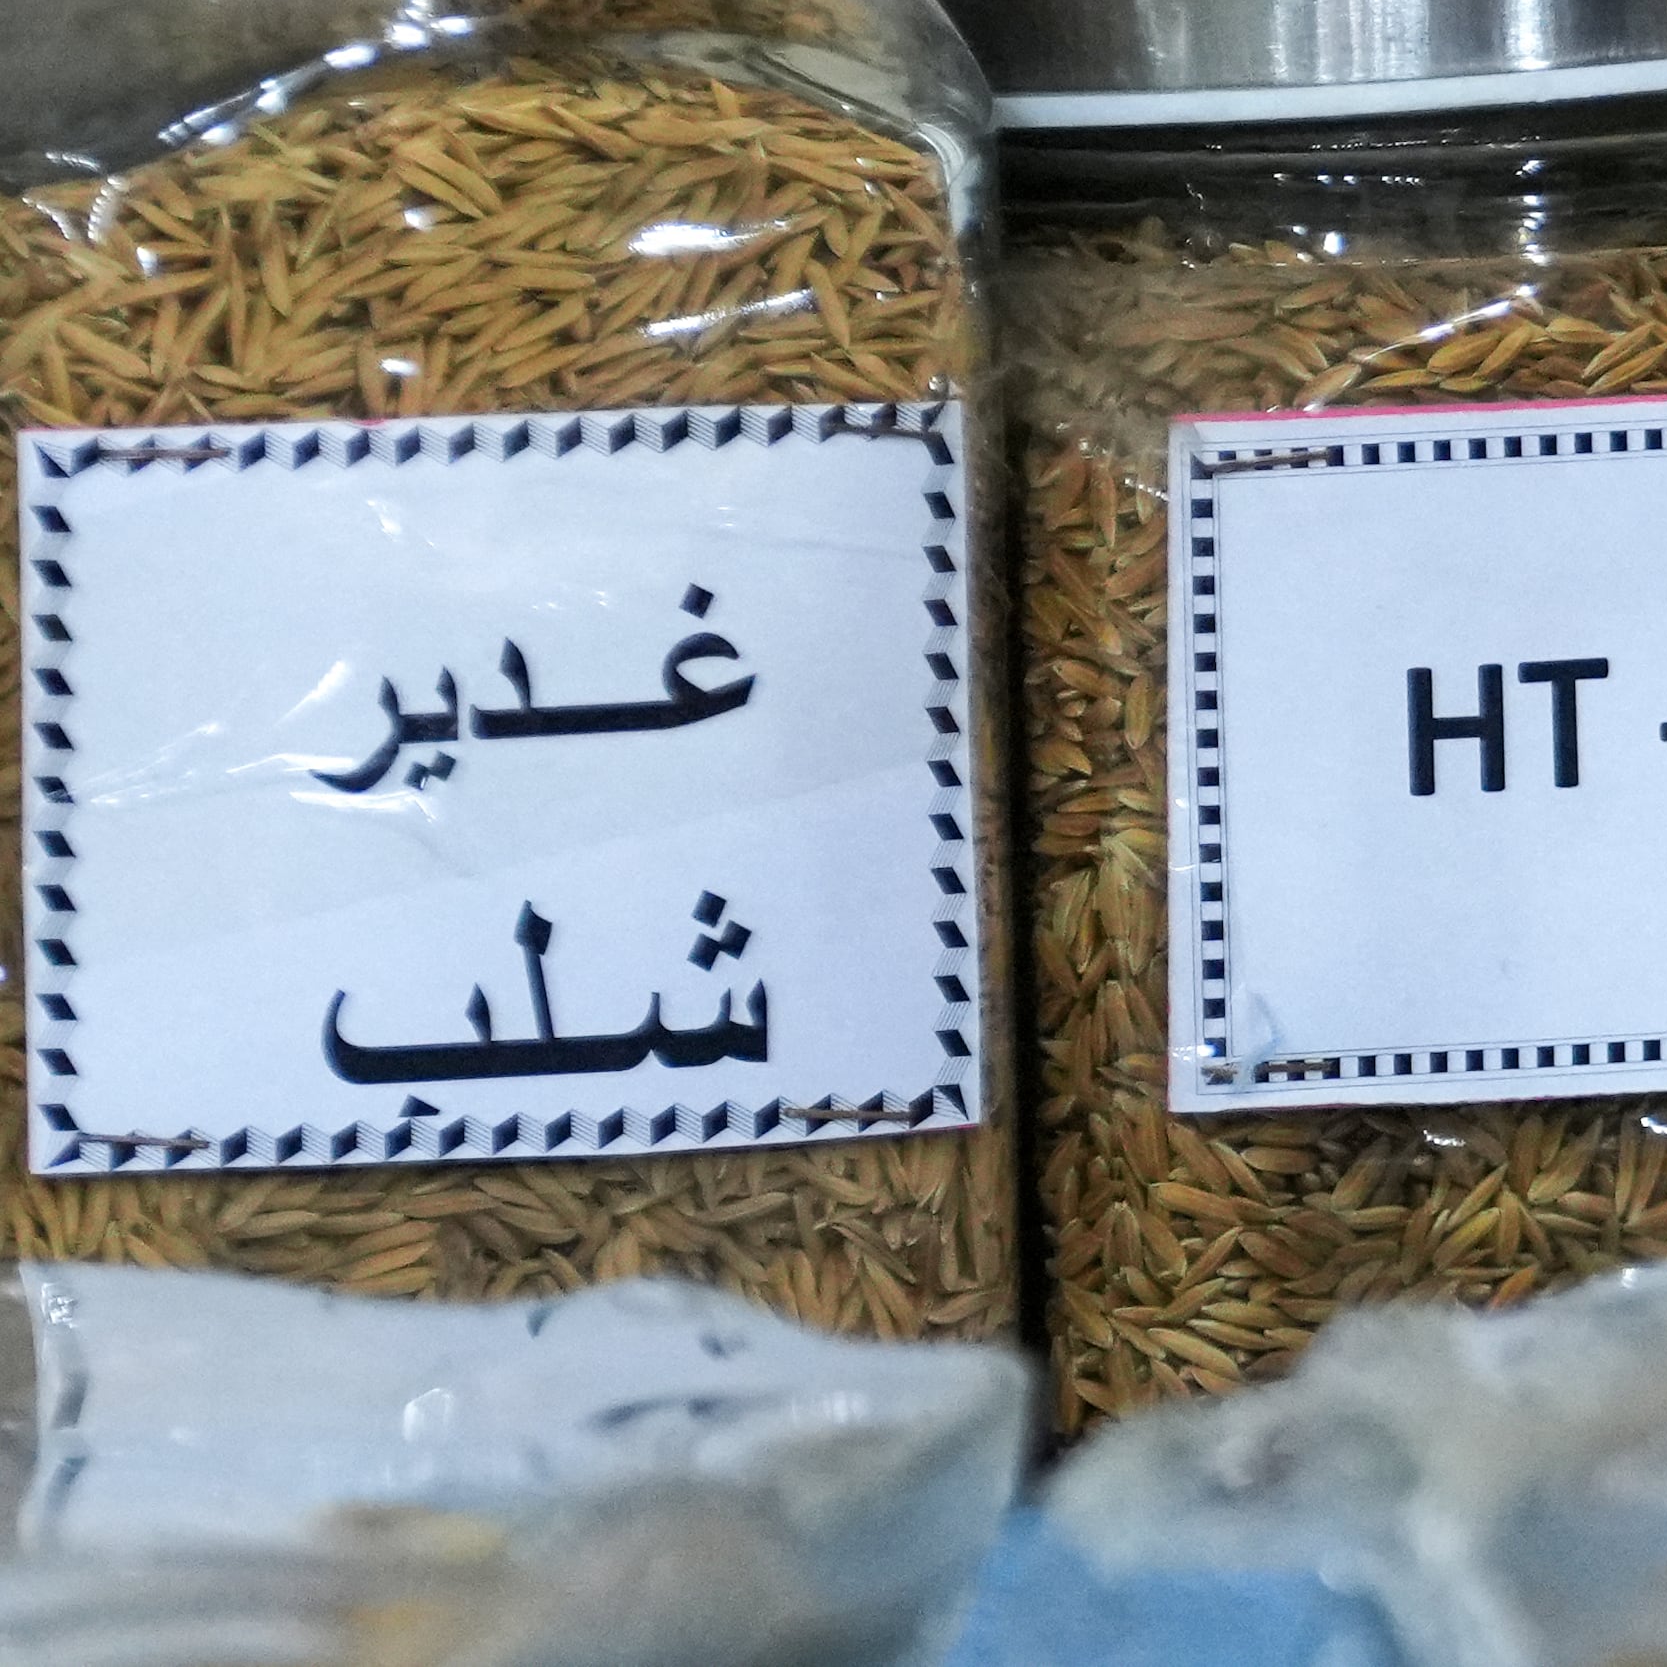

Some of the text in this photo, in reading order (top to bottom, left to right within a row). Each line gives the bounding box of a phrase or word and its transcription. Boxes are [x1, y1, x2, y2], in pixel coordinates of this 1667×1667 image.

[311, 583, 758, 794] غدير
[1407, 657, 1610, 796] HT
[321, 890, 769, 1117] شلب
